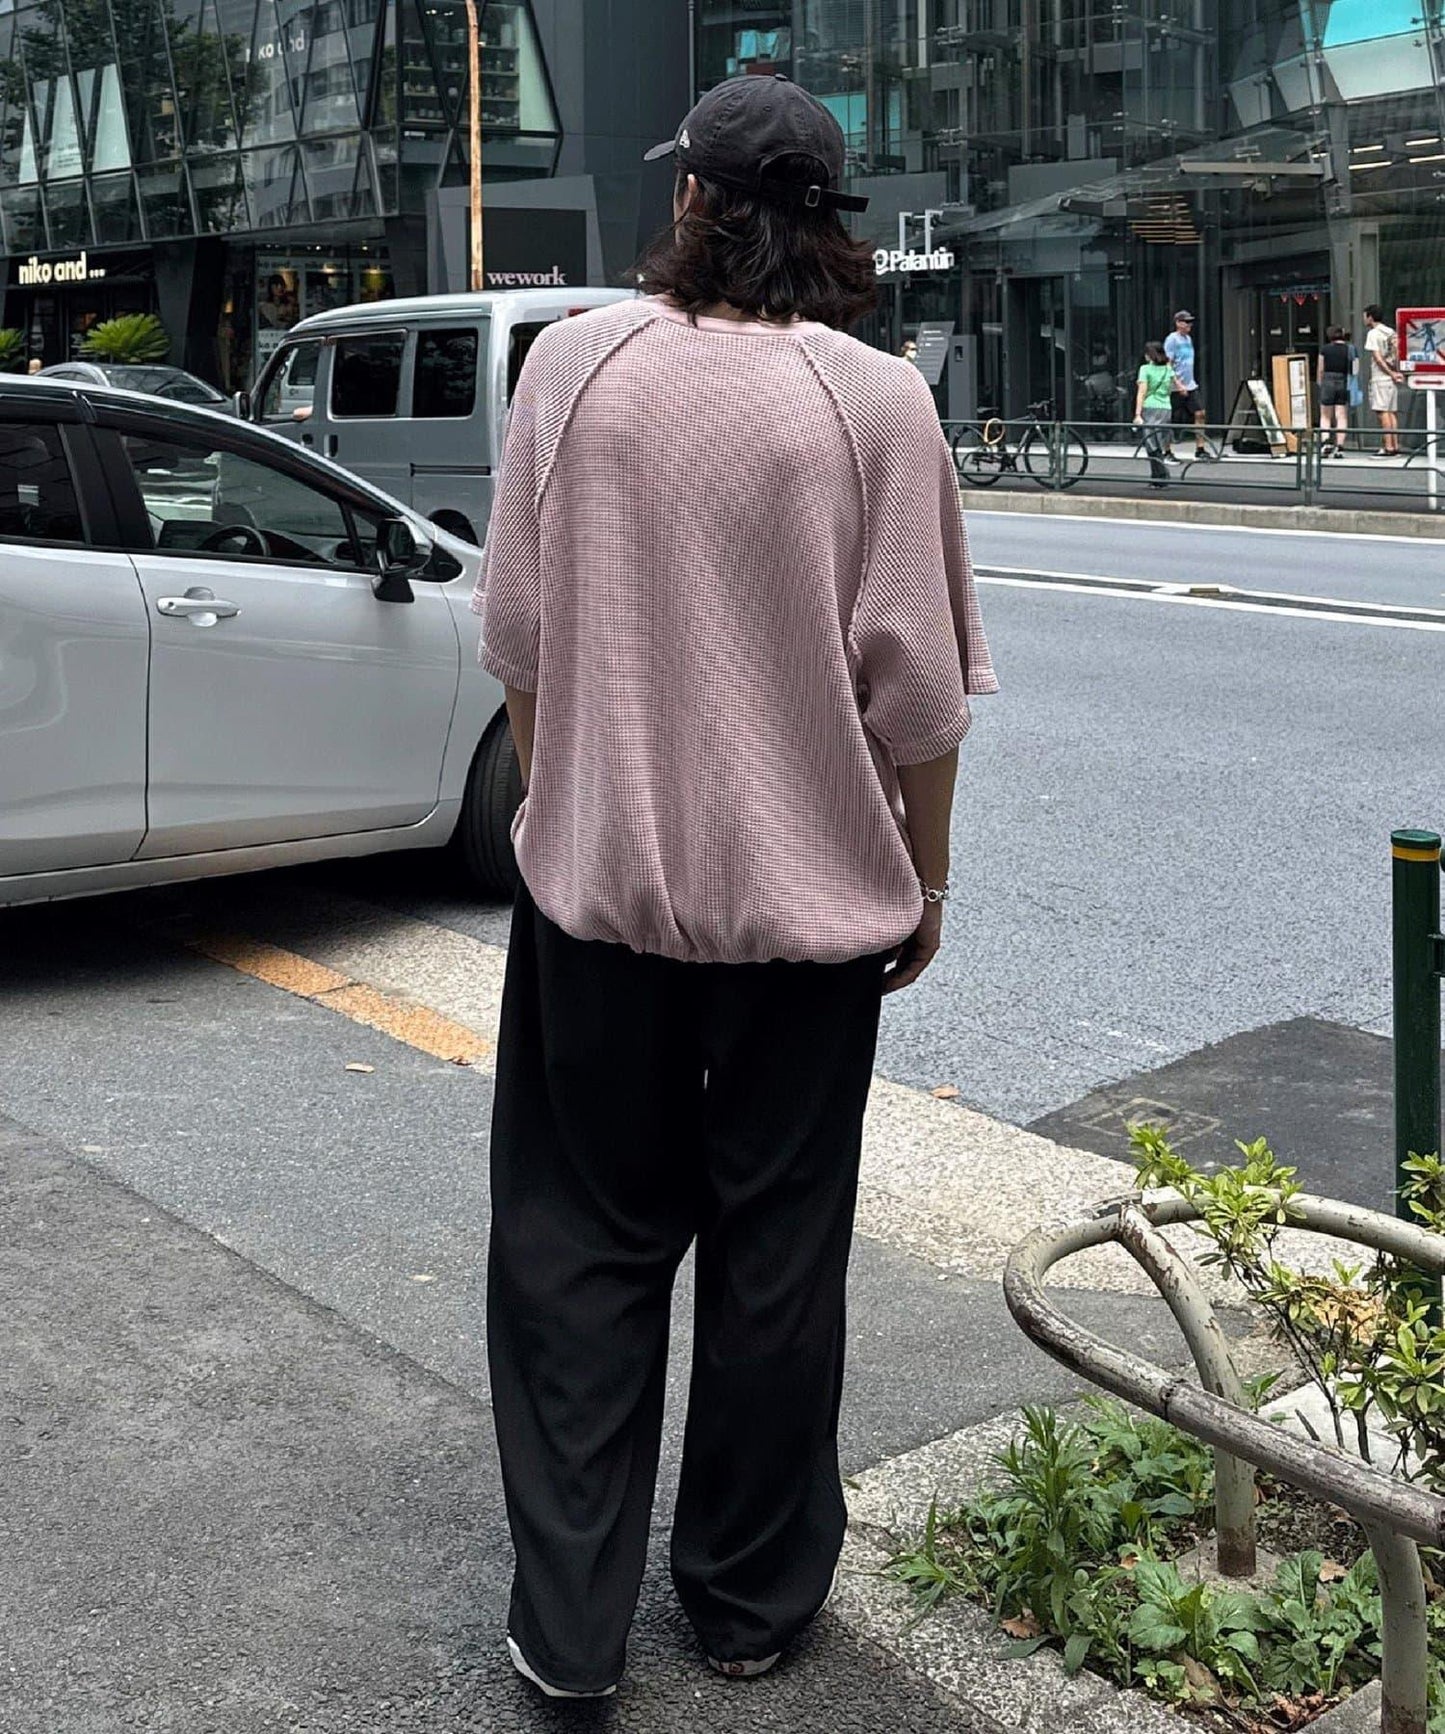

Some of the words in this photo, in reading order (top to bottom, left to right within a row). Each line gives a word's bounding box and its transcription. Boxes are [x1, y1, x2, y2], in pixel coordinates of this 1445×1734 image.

[18, 256, 52, 284] niko
[54, 251, 87, 281] and
[487, 265, 568, 285] wework
